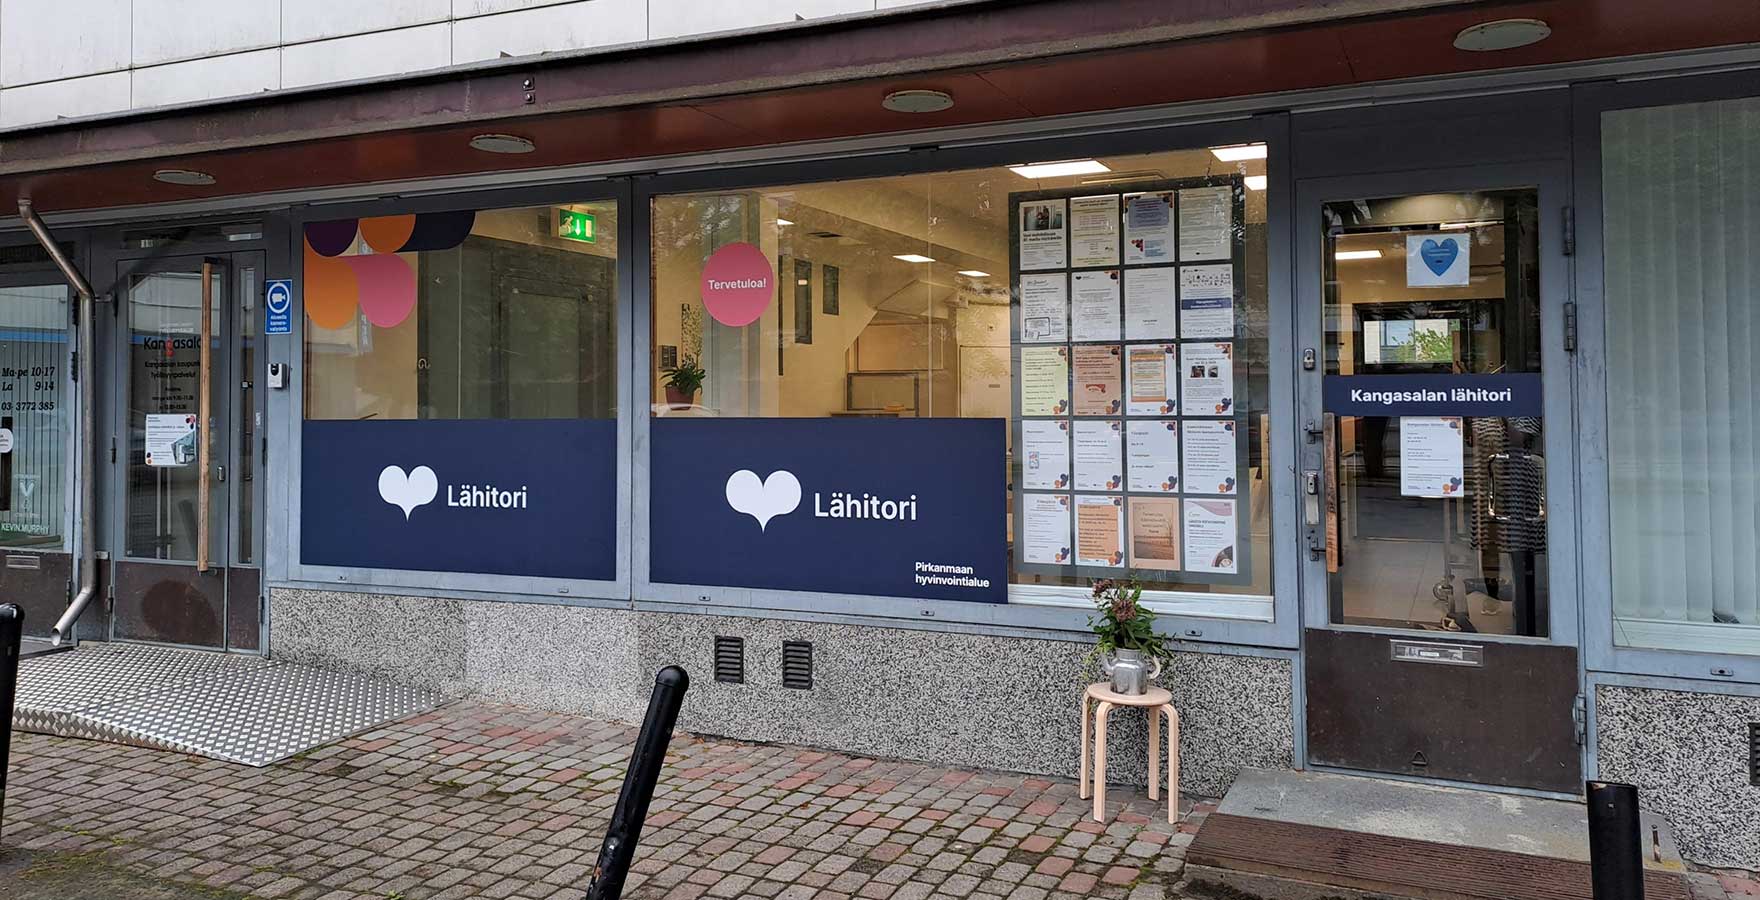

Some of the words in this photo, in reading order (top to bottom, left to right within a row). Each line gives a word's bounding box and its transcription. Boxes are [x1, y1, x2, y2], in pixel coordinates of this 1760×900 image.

[708, 277, 767, 290] Tervetuloa!
[2, 381, 13, 391] La
[1351, 388, 1447, 405] Kangasalan
[1451, 388, 1512, 402] lähitori
[15, 401, 36, 411] 3772
[38, 401, 55, 411] 385
[447, 484, 527, 509] Lähitori
[814, 492, 917, 521] Lähitori
[915, 561, 974, 575] Pirkanmaan
[915, 573, 990, 588] hyvinvointialue
